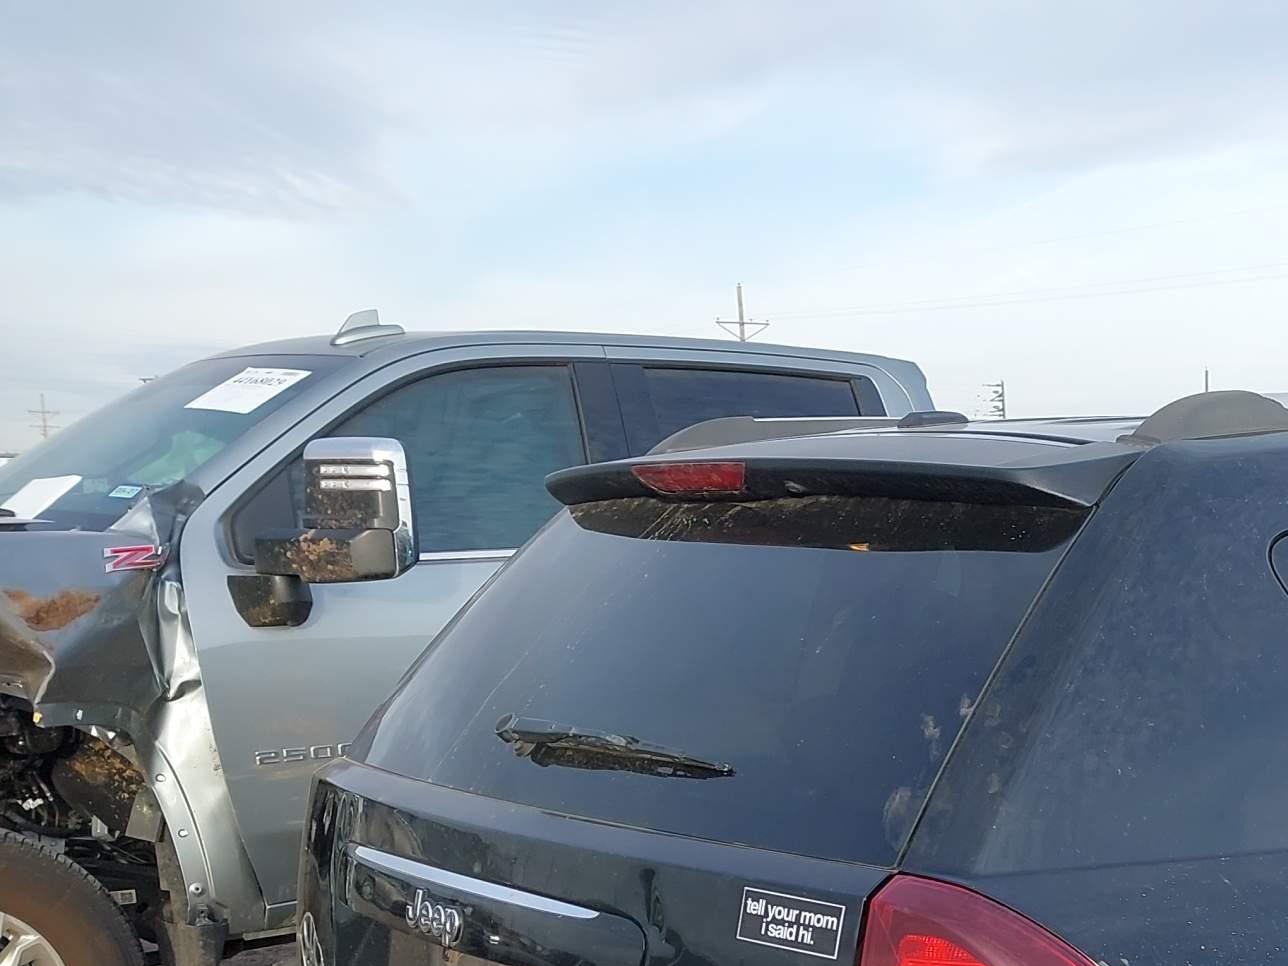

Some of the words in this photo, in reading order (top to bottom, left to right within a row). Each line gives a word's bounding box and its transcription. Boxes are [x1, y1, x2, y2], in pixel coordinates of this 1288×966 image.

[406, 888, 461, 947] Jeep
[746, 898, 766, 916] tell
[767, 904, 799, 922] your
[800, 911, 838, 931] mom
[761, 918, 767, 935] i
[767, 923, 797, 941] said
[798, 926, 814, 945] hi.
